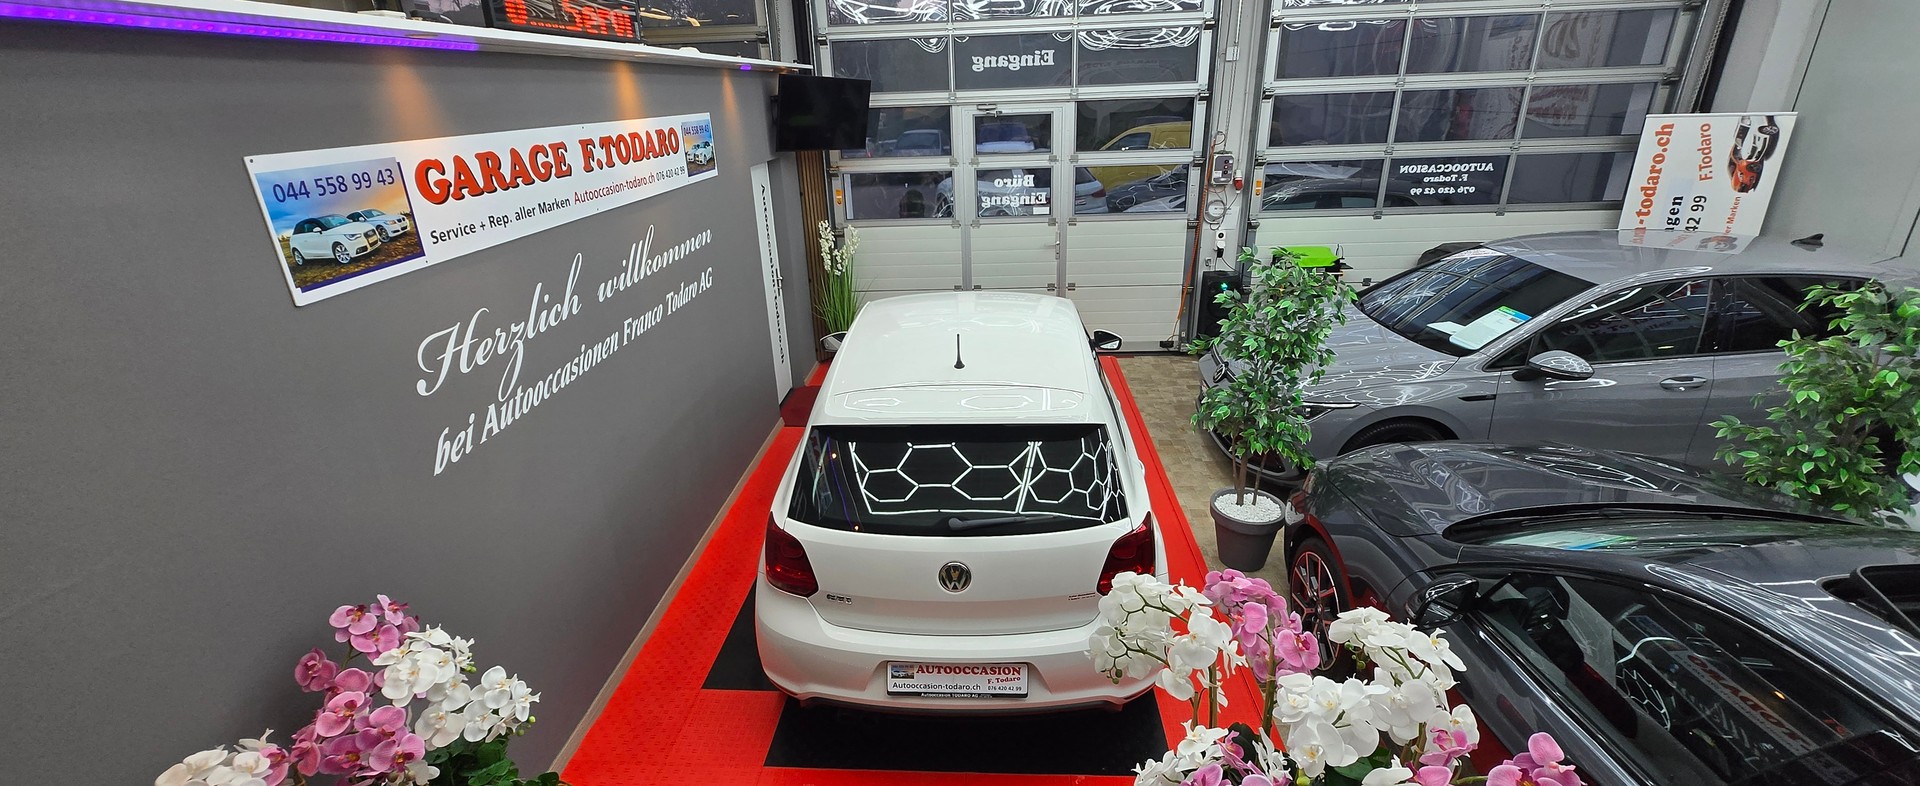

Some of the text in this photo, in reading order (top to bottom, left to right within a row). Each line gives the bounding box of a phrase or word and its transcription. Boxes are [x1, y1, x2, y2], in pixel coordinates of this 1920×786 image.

[272, 168, 395, 203] 044 558 99 43
[414, 140, 572, 206] GARAGE
[430, 165, 686, 245] Service + Rep. aller Marken Autooccasion-todaro.ch 076 420 42 99
[1690, 195, 1707, 212] 99
[1726, 196, 1741, 225] Marken
[415, 223, 713, 402] Herzlich willkommen
[433, 266, 714, 477] bei Autooccasionen Franco Todaro AG
[916, 664, 1022, 676] AUTOOCCASION
[995, 676, 1021, 684] Todaro
[892, 682, 981, 691] Autooccasion-todaro.ch
